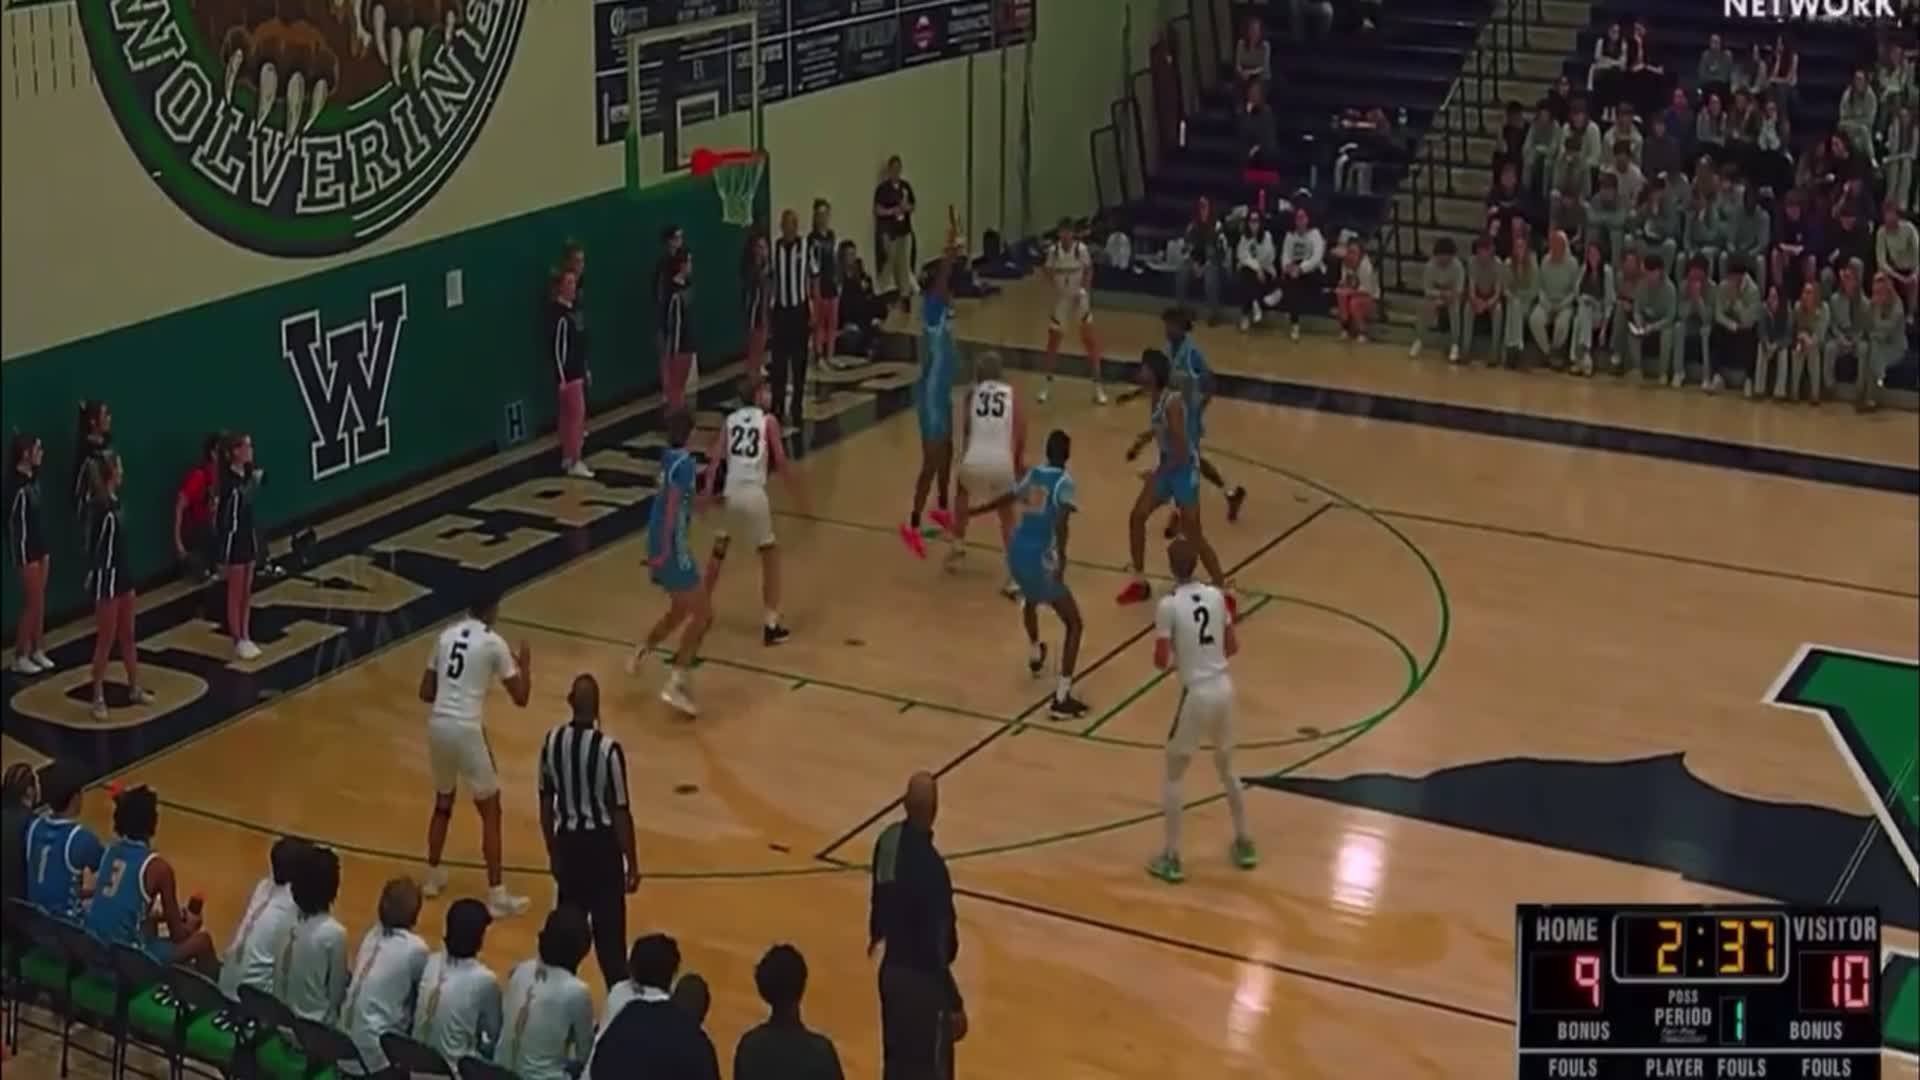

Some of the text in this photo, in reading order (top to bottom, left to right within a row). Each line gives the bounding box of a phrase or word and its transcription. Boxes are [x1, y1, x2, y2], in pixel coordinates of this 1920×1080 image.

[282, 284, 408, 481] W
[505, 401, 525, 442] H
[974, 390, 1007, 418] 35
[728, 424, 761, 459] 23
[1193, 606, 1215, 645] 2
[448, 642, 467, 679] 5
[37, 846, 51, 884] 1
[102, 857, 127, 897] 3
